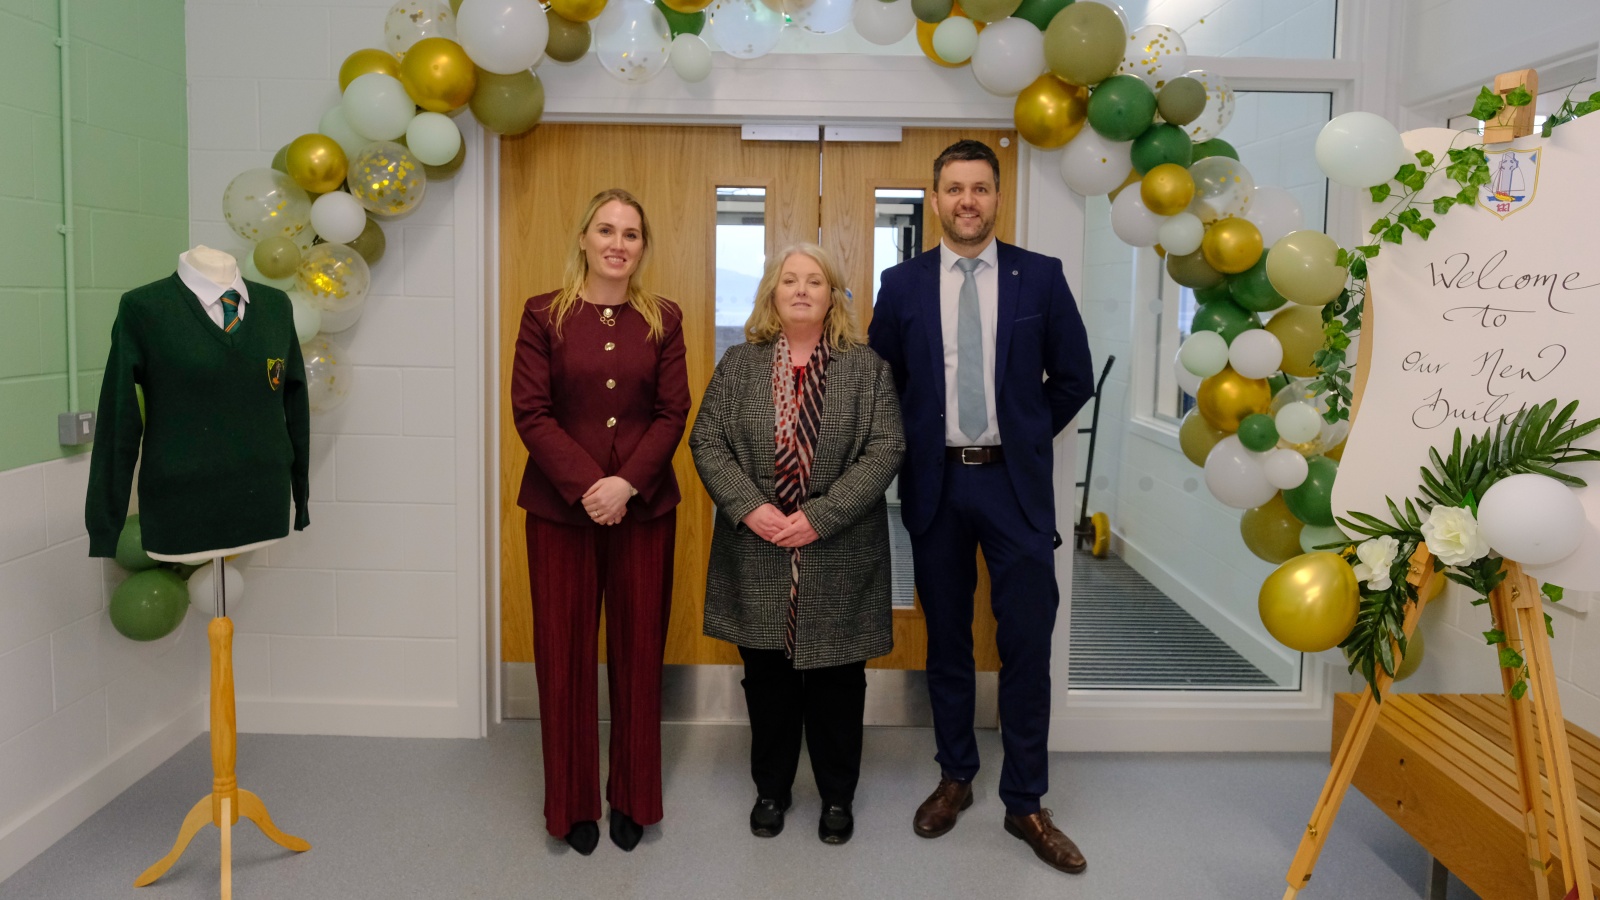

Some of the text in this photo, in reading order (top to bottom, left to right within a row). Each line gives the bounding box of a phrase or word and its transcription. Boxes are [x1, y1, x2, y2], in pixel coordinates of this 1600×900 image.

[1424, 250, 1600, 314] Welcome
[1443, 304, 1536, 328] to
[1402, 344, 1567, 397] Our New
